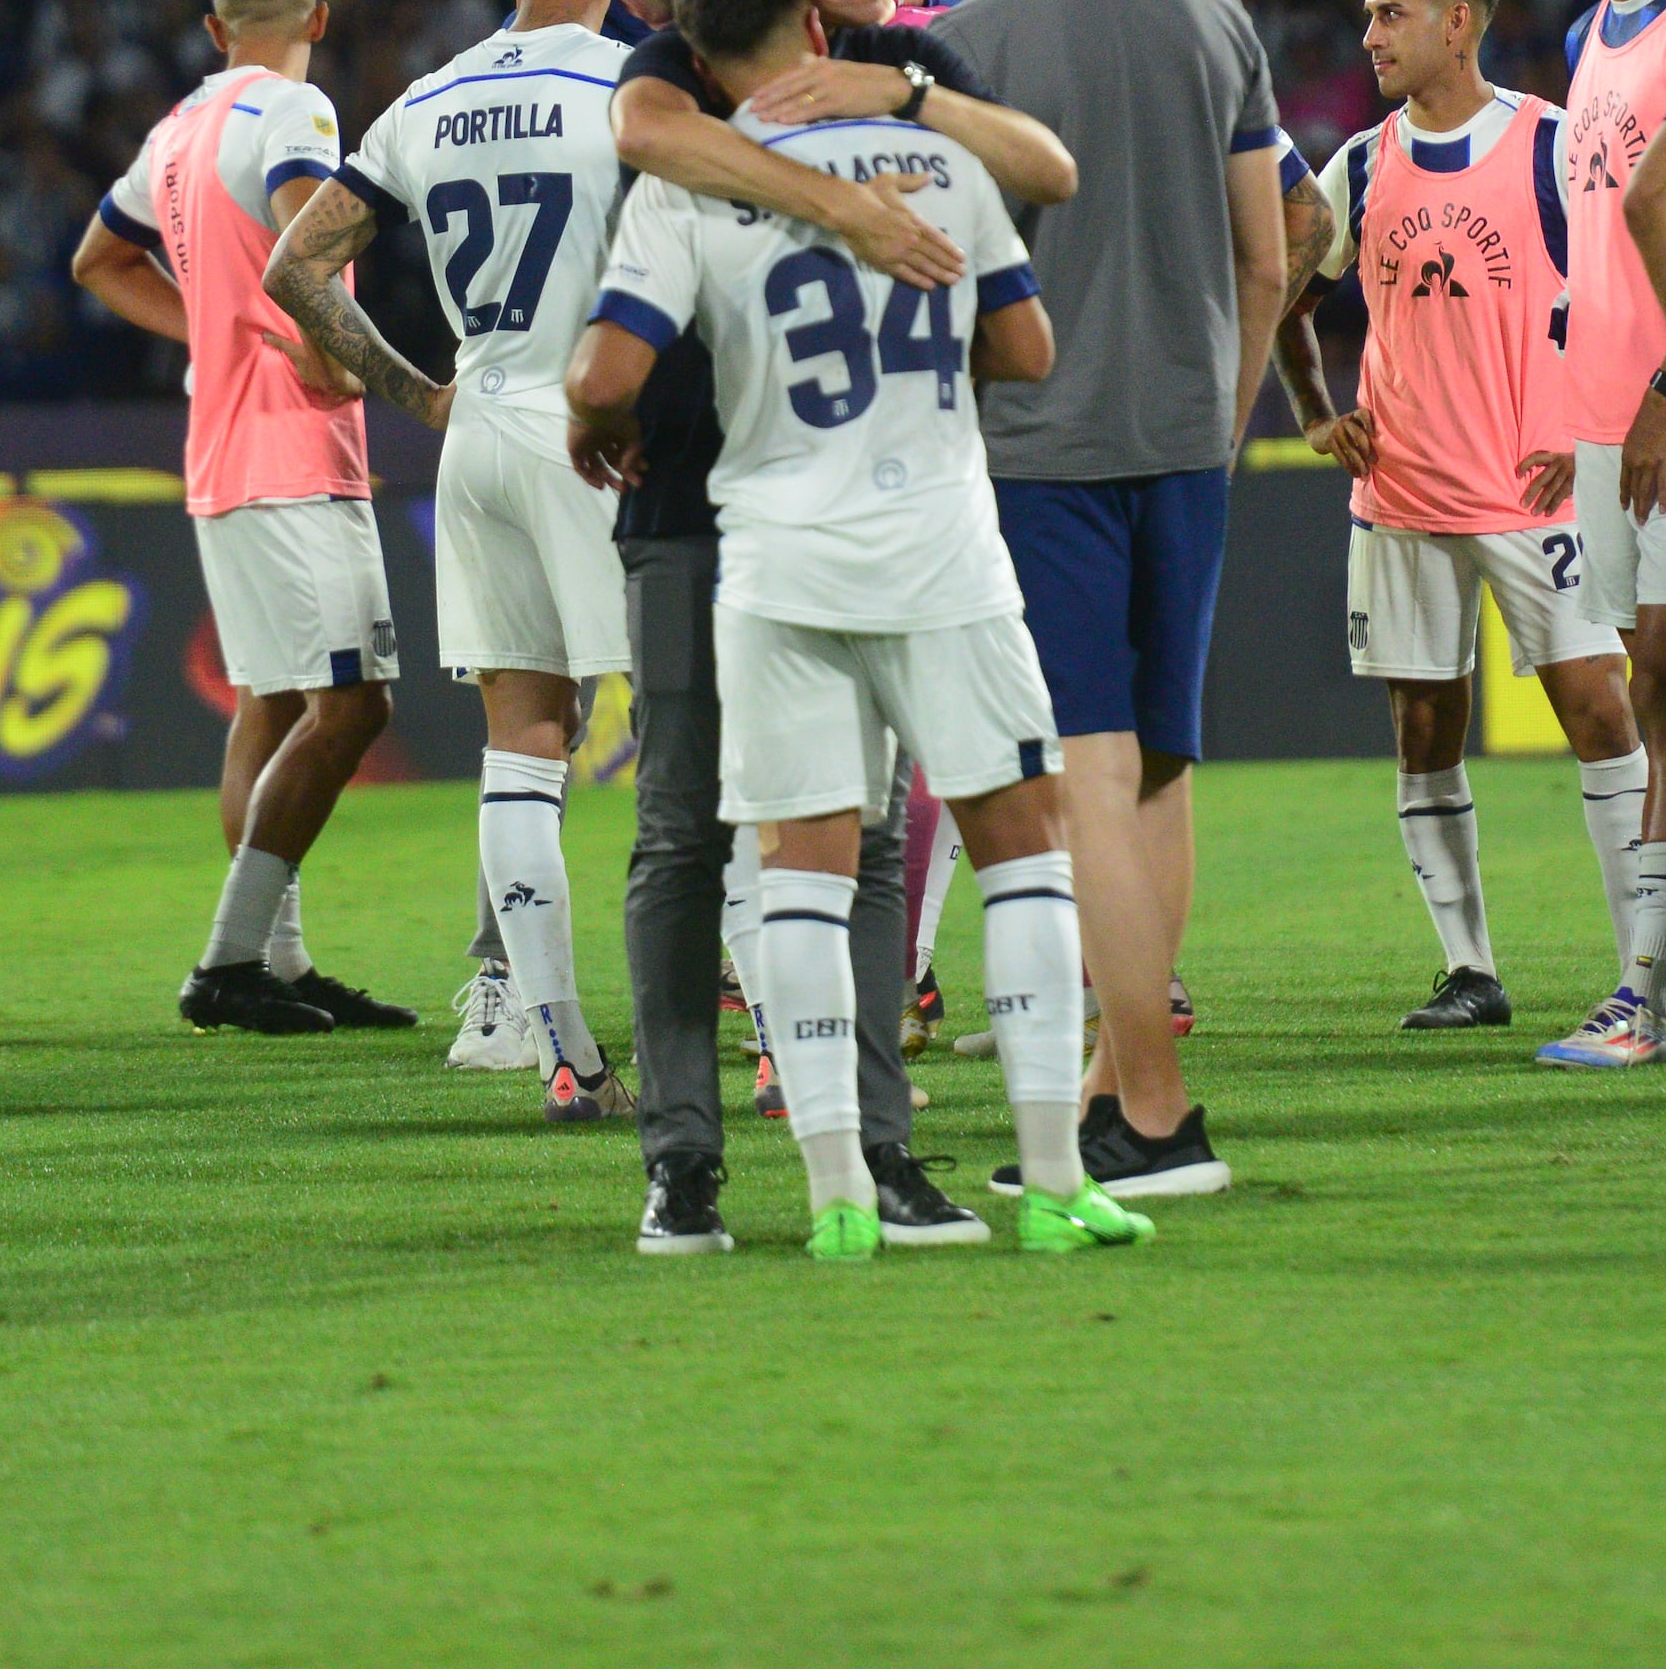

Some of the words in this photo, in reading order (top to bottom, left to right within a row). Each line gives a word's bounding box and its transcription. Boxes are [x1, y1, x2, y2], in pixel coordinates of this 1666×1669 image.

[434, 103, 563, 149] PORTILLA
[1604, 89, 1647, 168] SPORTI
[813, 151, 952, 189] ACIOS
[426, 172, 573, 337] 27
[1388, 206, 1432, 251] COQ
[1440, 202, 1512, 290] SPORTIF
[1379, 255, 1399, 286] LE
[764, 244, 964, 429] 34
[1542, 532, 1583, 591] 2
